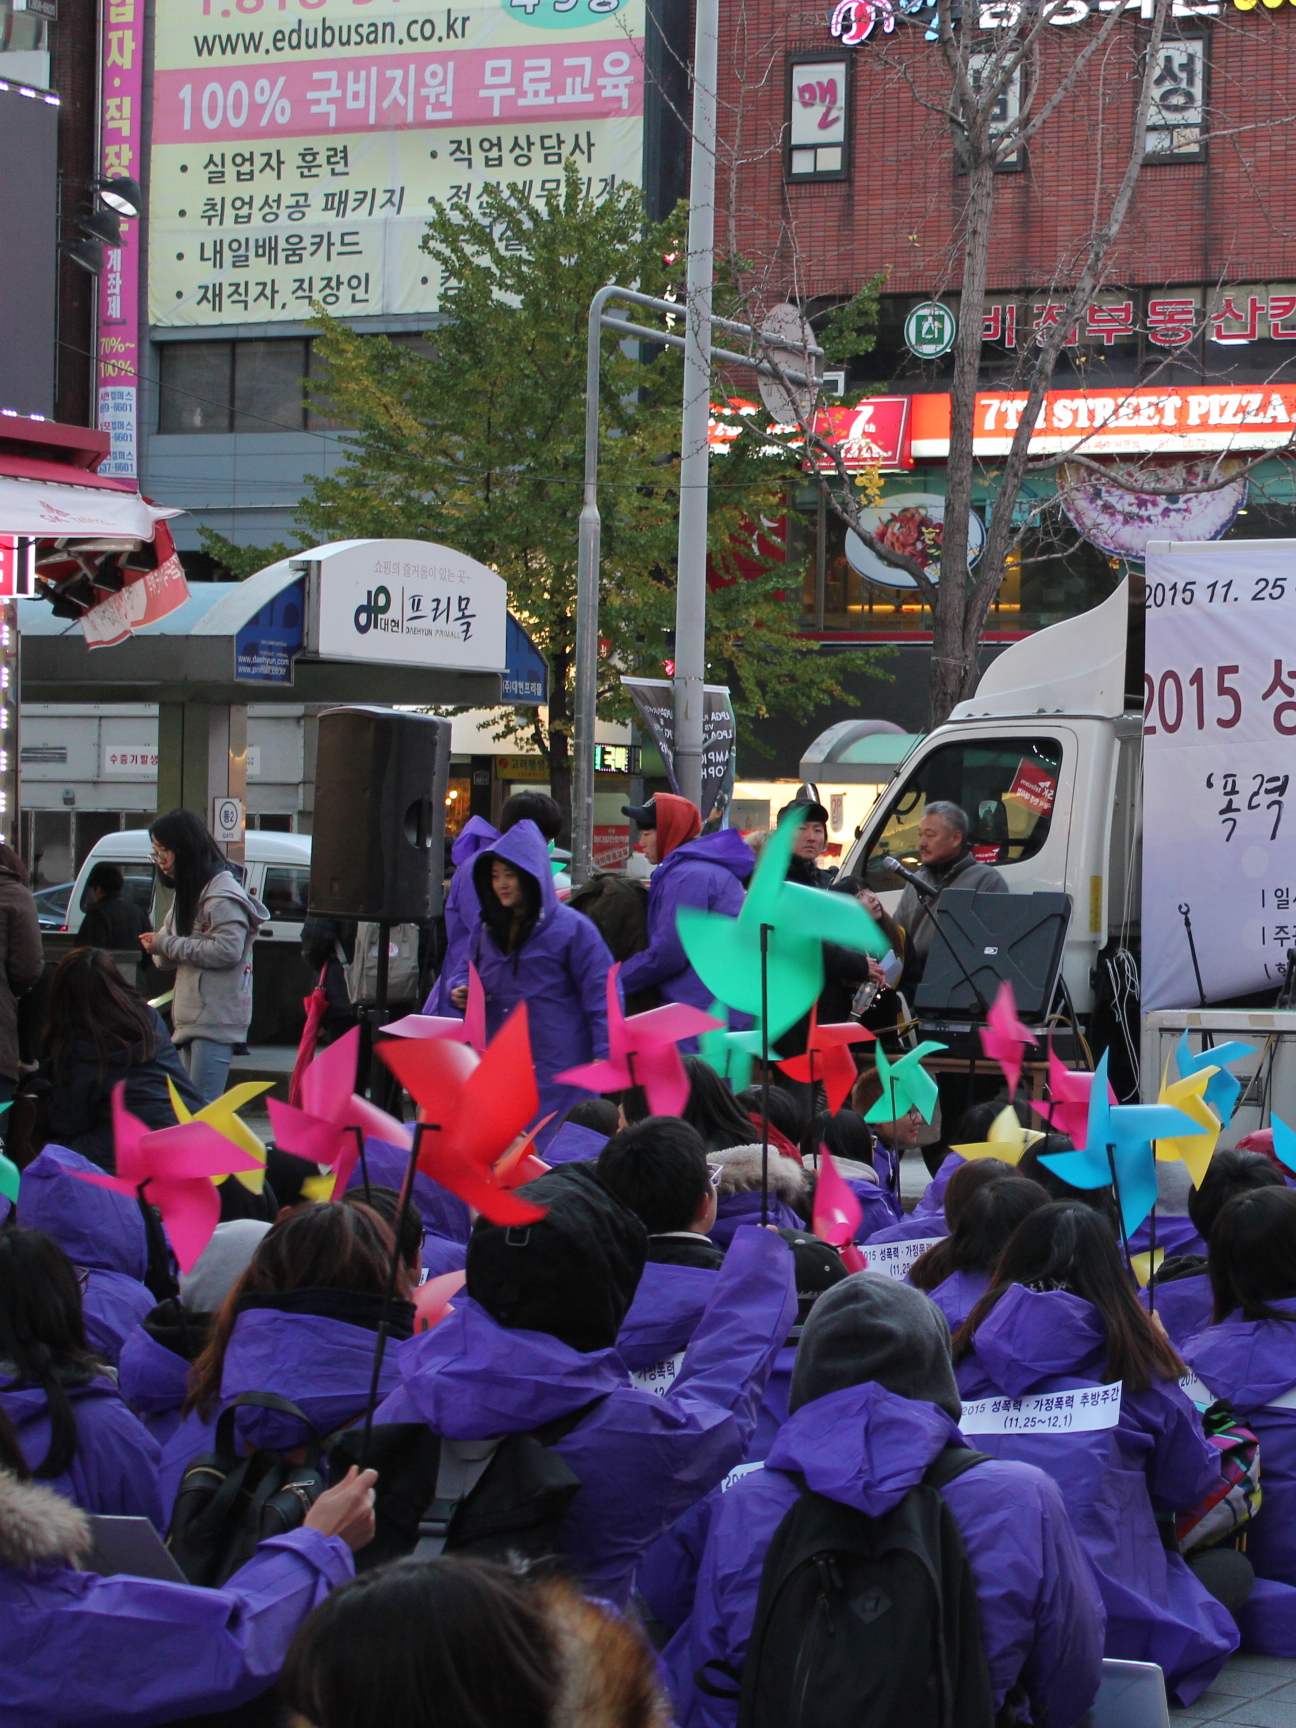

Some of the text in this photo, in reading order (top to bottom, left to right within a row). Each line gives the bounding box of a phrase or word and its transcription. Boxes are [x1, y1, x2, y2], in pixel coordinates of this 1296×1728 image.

[194, 10, 470, 57] www.edubusan.co.kr
[179, 51, 634, 130] 100% 국비지원 무료교육
[203, 145, 350, 184] 실업자 훈련
[448, 132, 596, 168] 직업상담사
[200, 186, 405, 226] 취업성공 패키지
[199, 232, 363, 269] 내일배움카드
[196, 273, 371, 312] 재직자,직장인
[1052, 396, 1190, 429] STREET
[1187, 393, 1291, 425] PIZZA
[374, 560, 400, 576] 쇼핑의
[403, 563, 437, 580] 즐거움이
[439, 567, 455, 582] 있는
[1145, 581, 1196, 609] 2015
[1205, 579, 1239, 604] 11.
[1251, 577, 1287, 601] 25
[380, 618, 399, 633] 대현
[406, 594, 476, 642] 프리몰
[1144, 664, 1242, 736] 2015
[880, 1247, 899, 1261] 성폭력
[962, 1385, 1120, 1416] 2015 성폭력 가정폭력 추방주간
[1003, 1413, 1073, 1429] (11.25~12.1)
